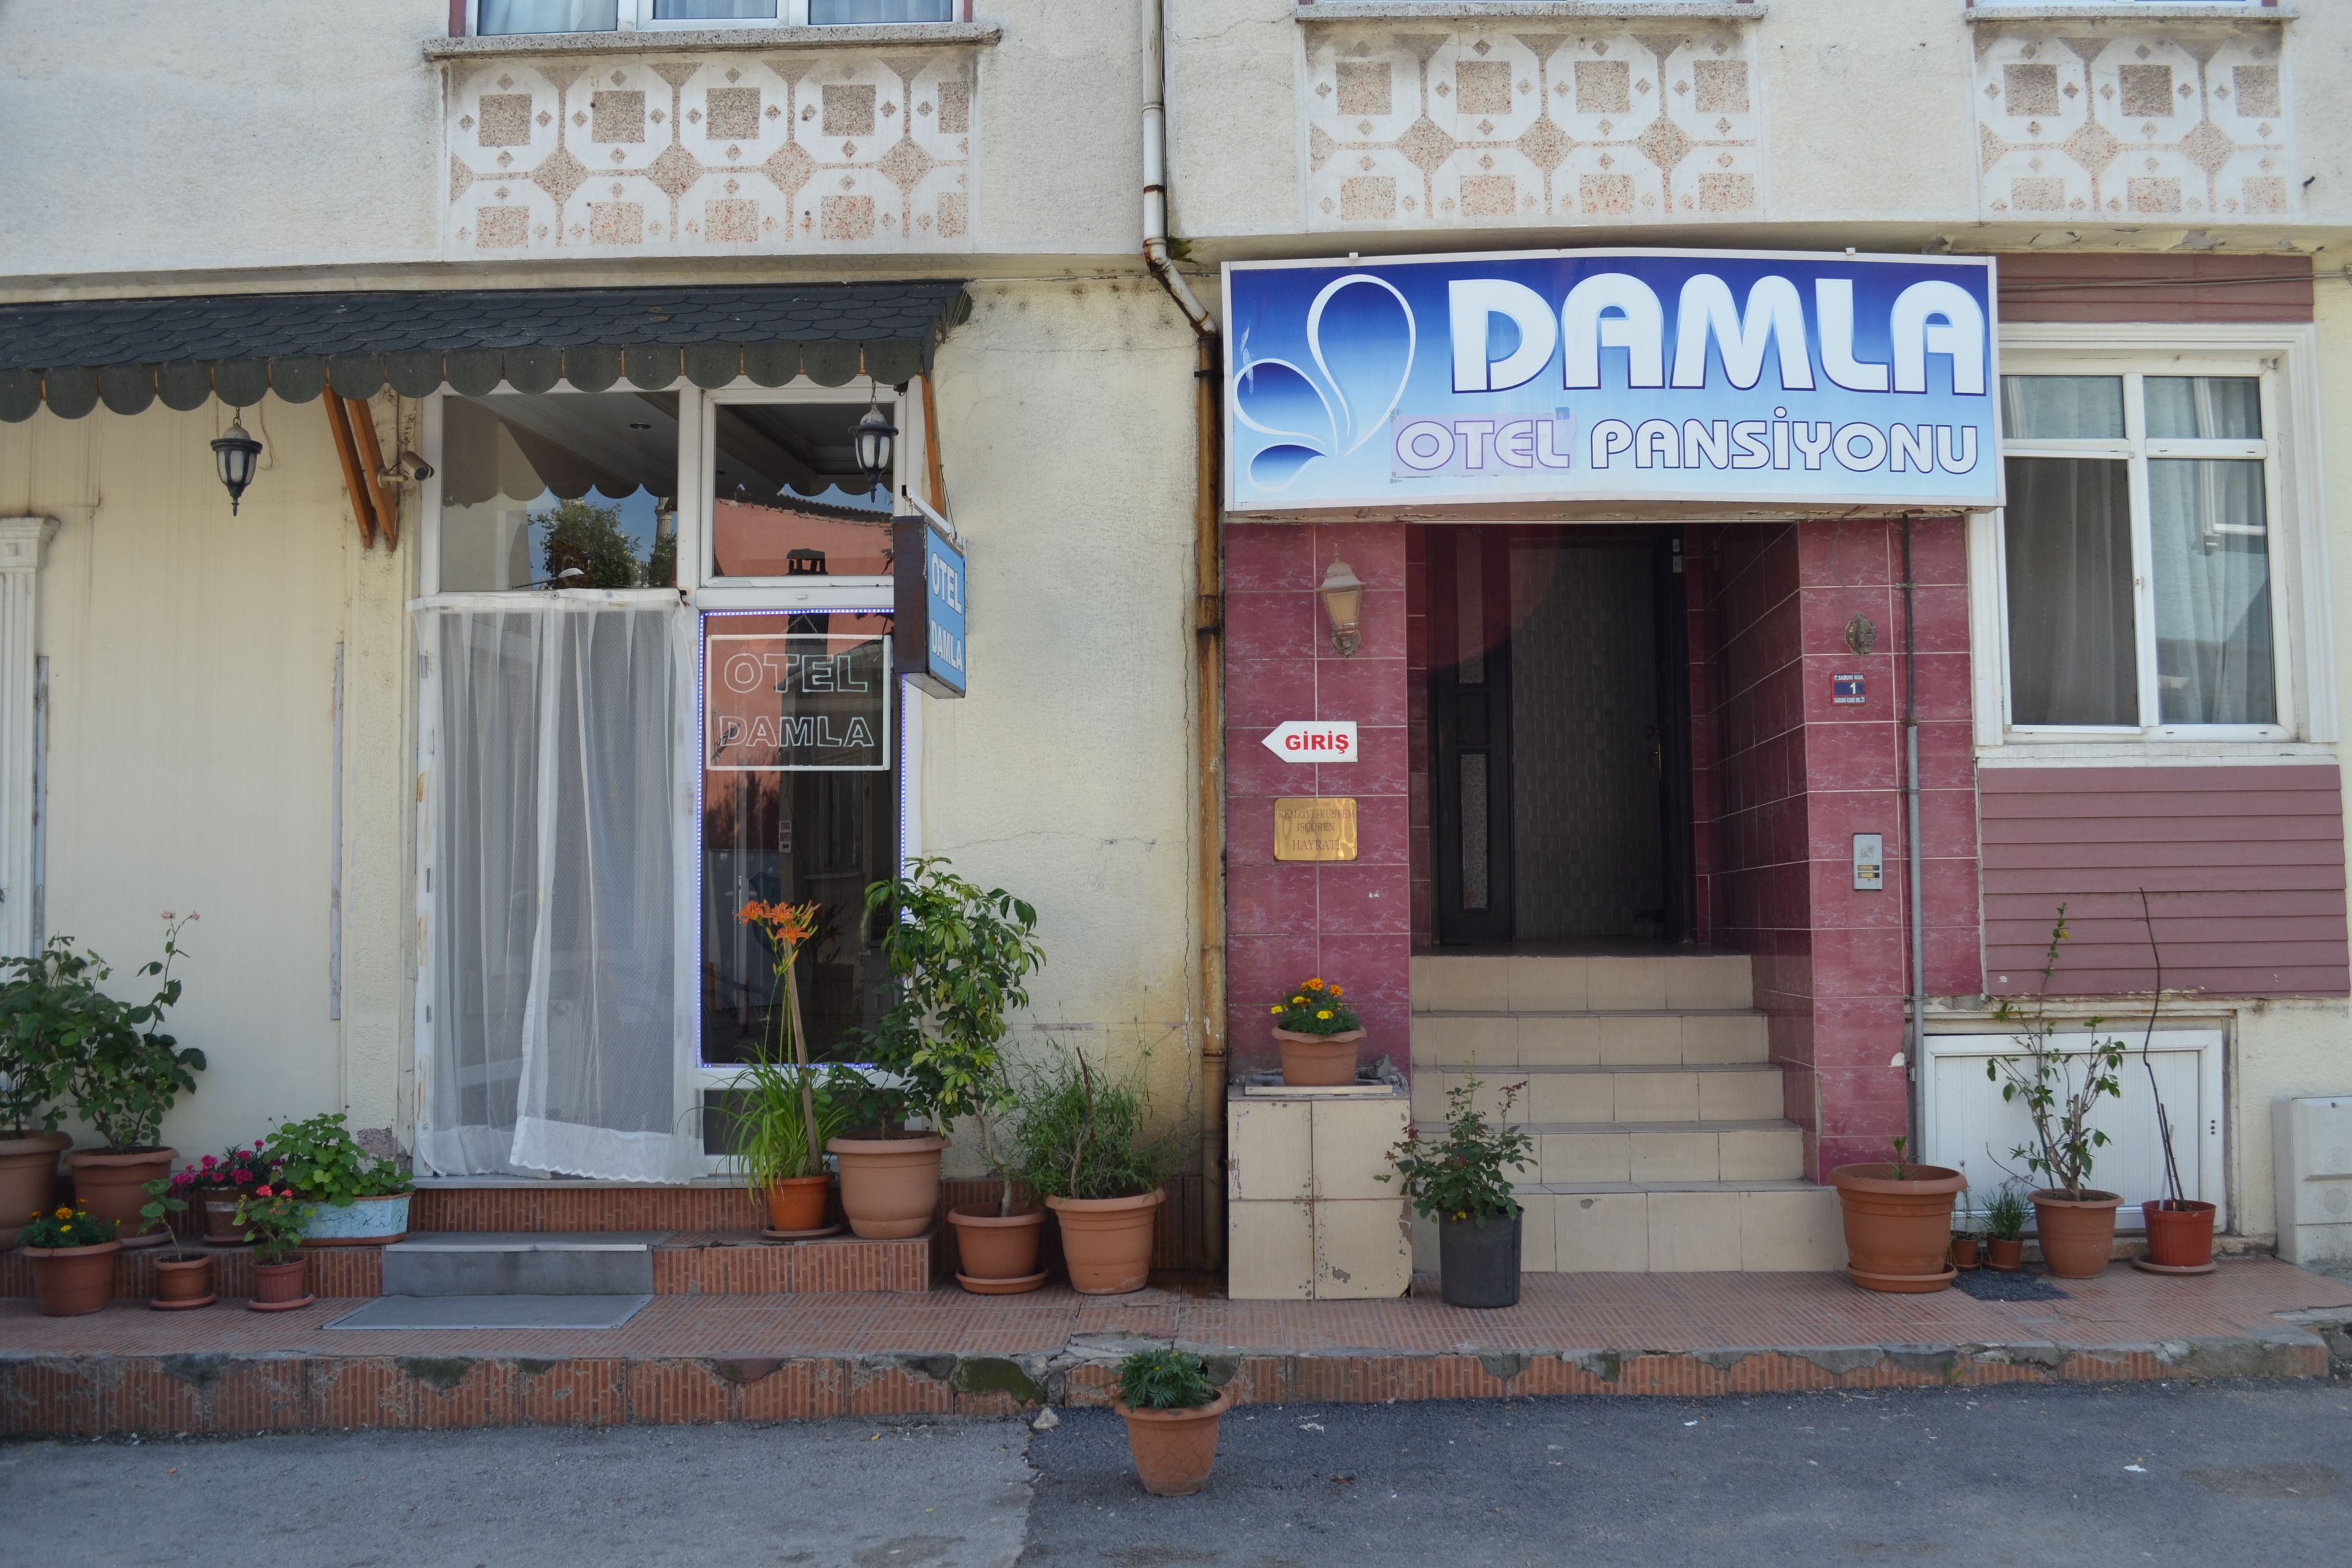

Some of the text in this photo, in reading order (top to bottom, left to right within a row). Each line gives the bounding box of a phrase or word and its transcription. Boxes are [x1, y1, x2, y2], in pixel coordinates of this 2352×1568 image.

[1448, 272, 1988, 397] DAMLA
[1396, 406, 1979, 473] OTEL PANSİYONU
[931, 552, 962, 614] OTEL
[930, 619, 963, 673] DAMLA
[723, 652, 869, 693] OTEL
[1850, 682, 1856, 694] 1
[719, 715, 874, 747] DAMLA
[1285, 731, 1349, 754] GİRİŞ
